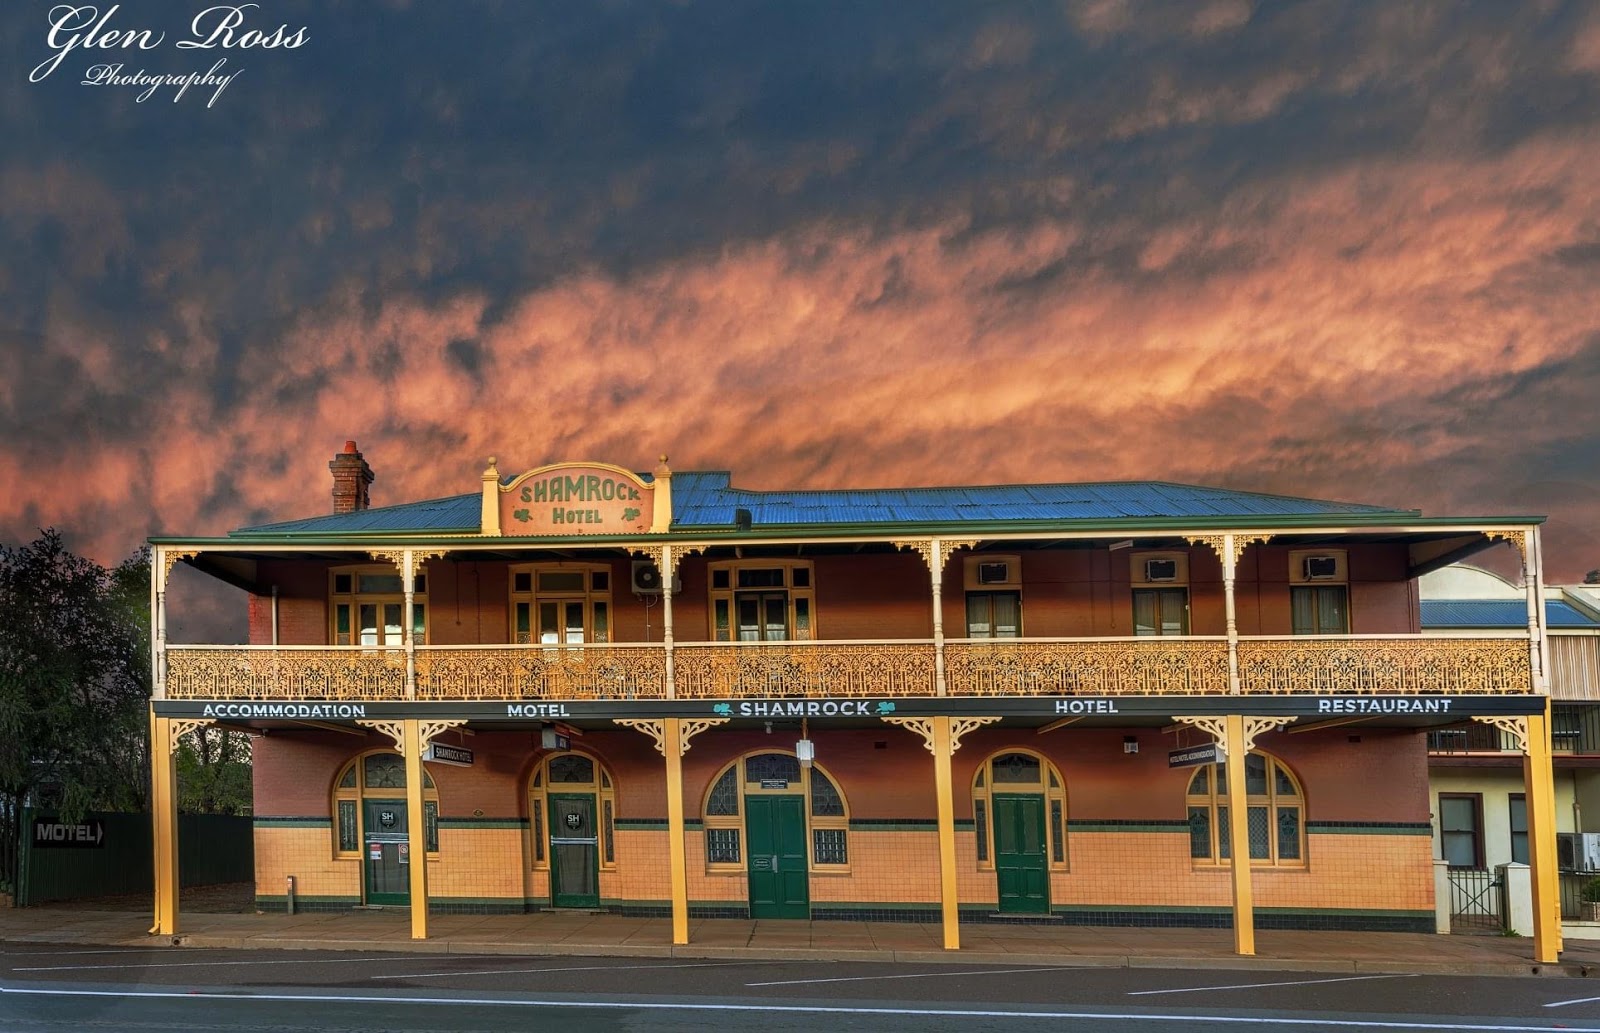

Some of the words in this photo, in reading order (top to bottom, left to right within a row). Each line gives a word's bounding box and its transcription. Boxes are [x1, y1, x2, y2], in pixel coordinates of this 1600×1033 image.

[520, 475, 641, 502] SHAMROCK
[202, 703, 366, 718] ACCOMMODATION
[507, 703, 570, 718] MOTEL
[740, 701, 870, 716] SHAMROCK
[1055, 699, 1119, 714] HOTEL
[1318, 698, 1453, 713] RESTAURANT
[436, 747, 460, 761] SHAMROCK
[381, 812, 394, 820] SH
[567, 814, 580, 822] SH
[37, 823, 95, 841] MOTEL
